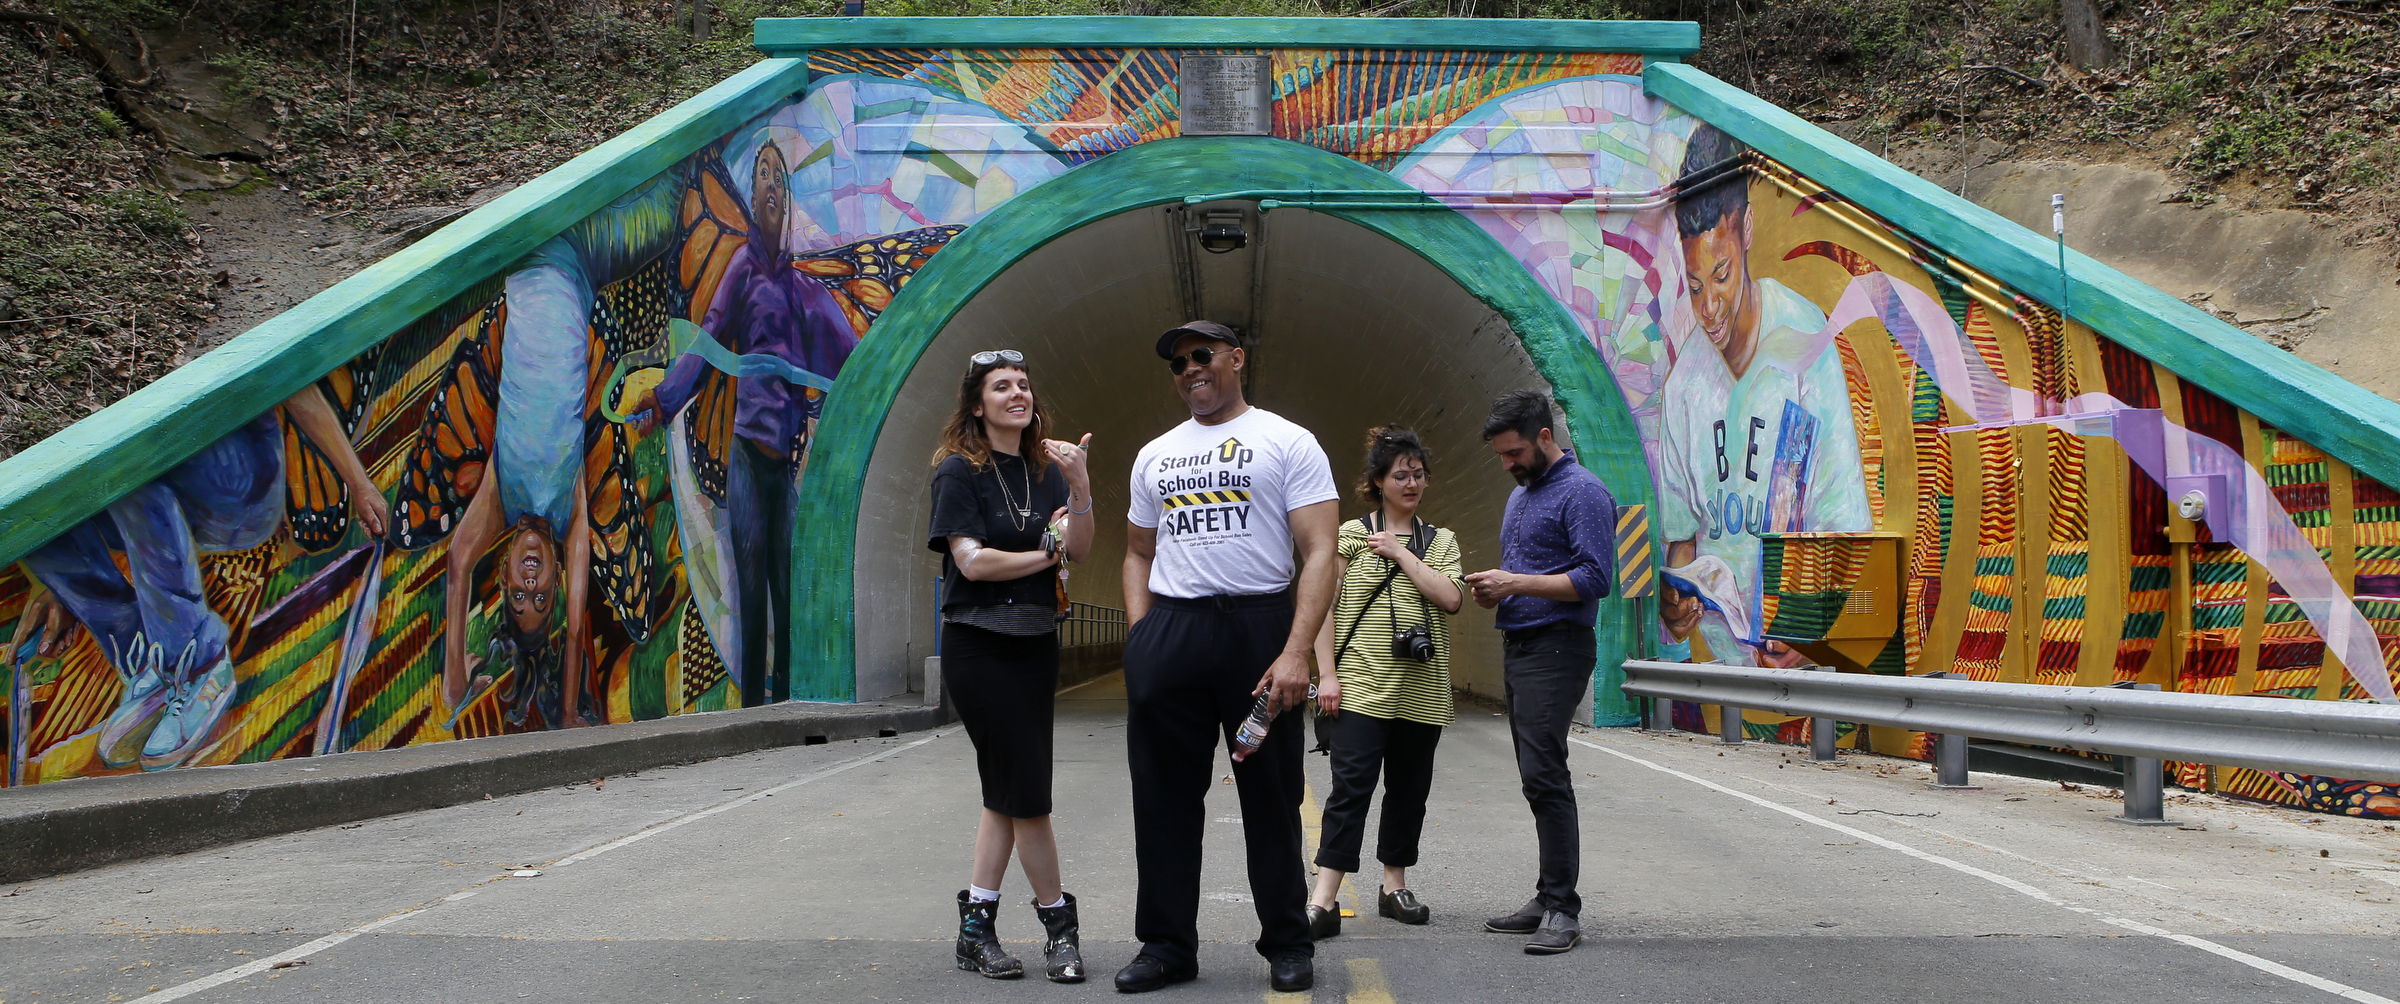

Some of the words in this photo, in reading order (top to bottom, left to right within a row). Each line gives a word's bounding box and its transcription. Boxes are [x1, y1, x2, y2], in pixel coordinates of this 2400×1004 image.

[1185, 59, 1224, 69] WILCOX
[1227, 59, 1267, 70] TUNNEL
[1158, 450, 1213, 473] Stand
[1218, 441, 1254, 469] Up
[1712, 416, 1766, 483] BE
[1158, 471, 1213, 497] School
[1218, 470, 1252, 488] Bus
[1190, 467, 1203, 476] for
[1166, 505, 1251, 537] SAFETY
[1706, 488, 1764, 541] YOU
